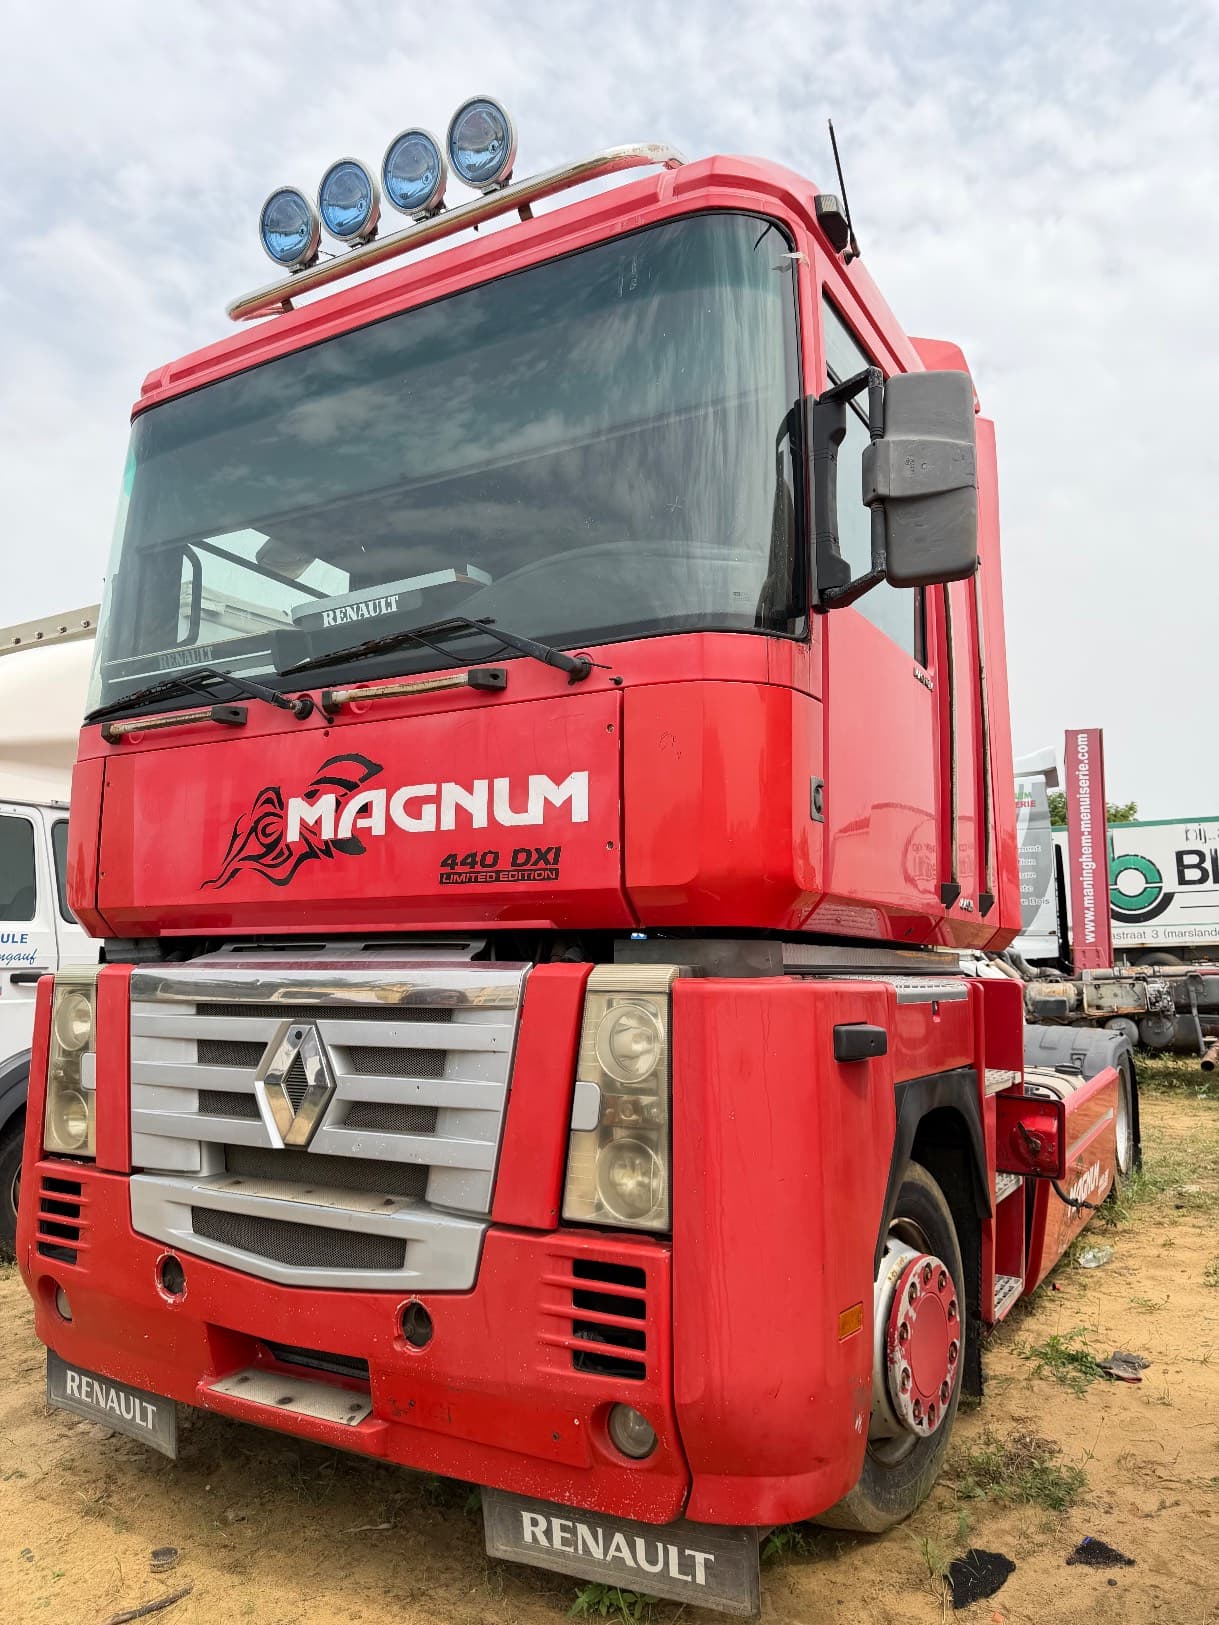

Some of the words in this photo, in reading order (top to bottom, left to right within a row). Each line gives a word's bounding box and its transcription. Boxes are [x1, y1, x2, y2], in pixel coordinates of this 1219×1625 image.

[322, 595, 399, 628] RENAULT
[158, 646, 214, 670] RENAULT
[286, 770, 589, 843] MAGNUM
[1076, 733, 1097, 943] www.maninghem-menuiserie.com
[441, 850, 500, 870] 440
[512, 847, 562, 868] DXI
[443, 872, 496, 883] LIMITED
[500, 870, 556, 881] EDITION
[0, 933, 29, 944] ULE
[1151, 929, 1159, 939] 3
[66, 1369, 157, 1430] RENAULT
[520, 1510, 715, 1586] RENAULT
